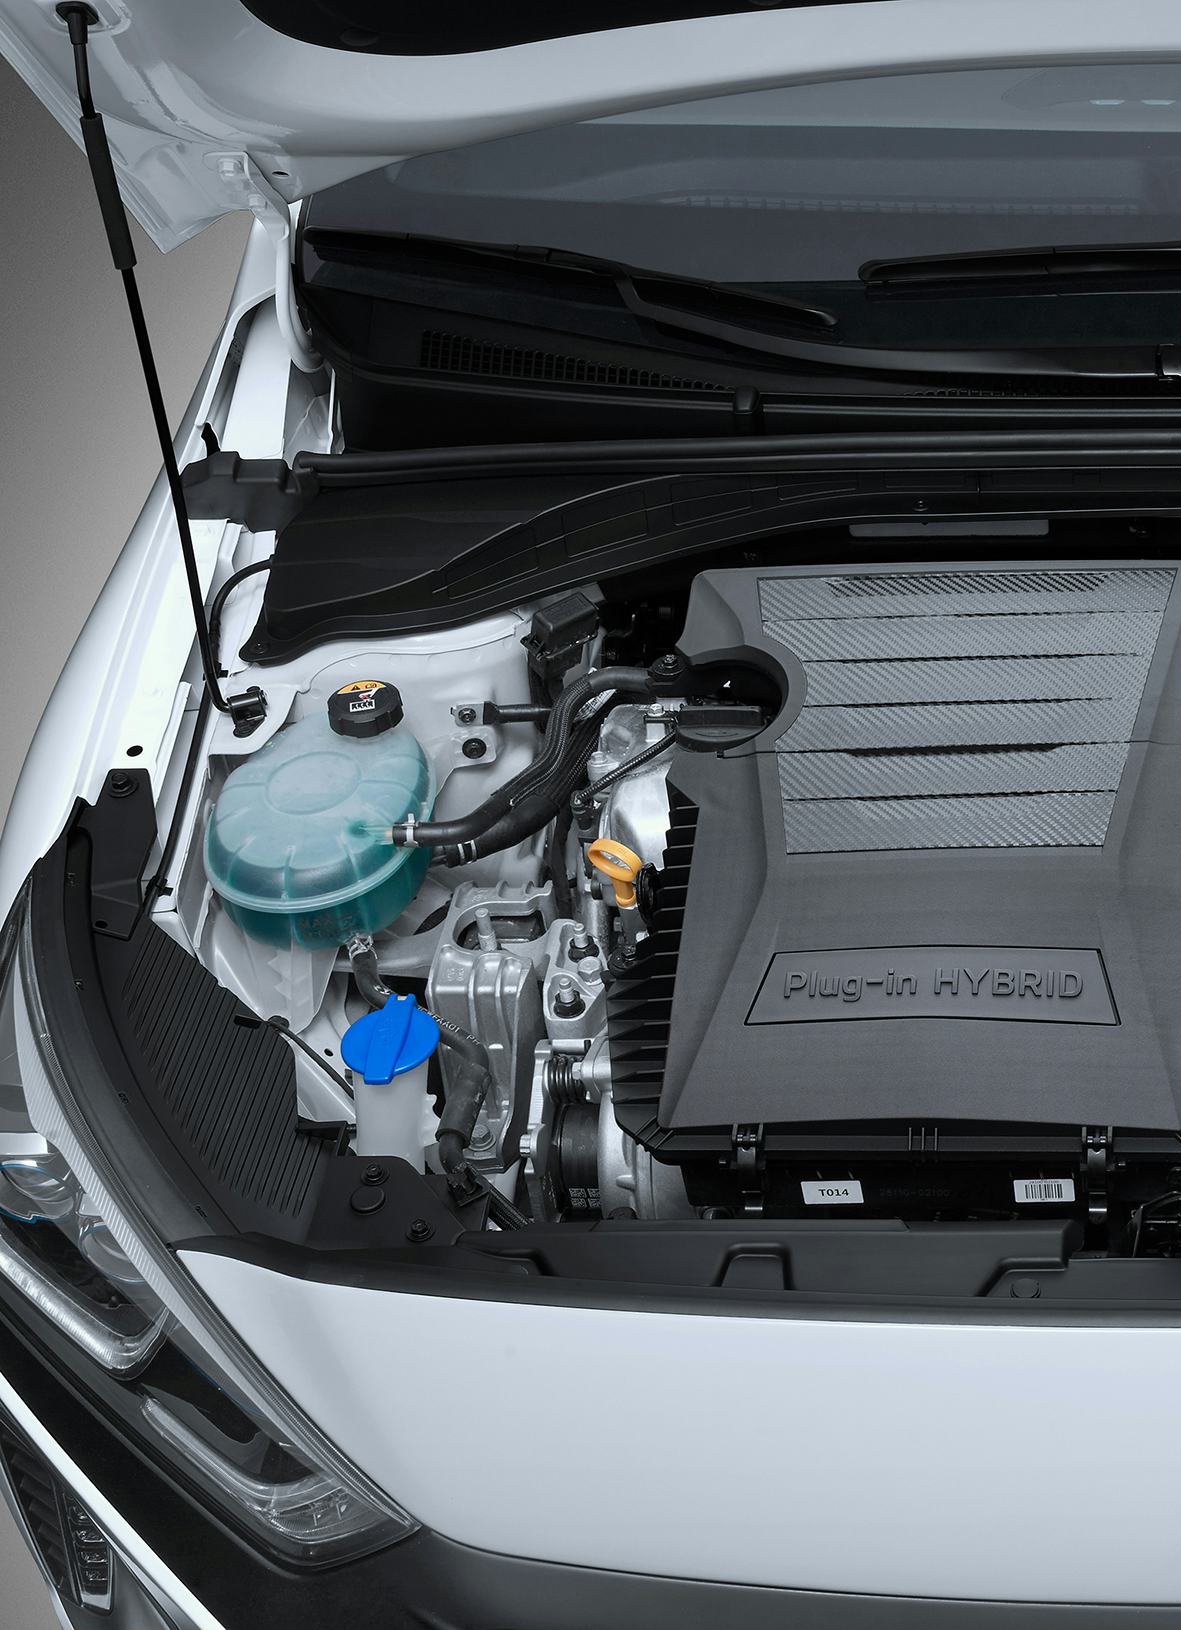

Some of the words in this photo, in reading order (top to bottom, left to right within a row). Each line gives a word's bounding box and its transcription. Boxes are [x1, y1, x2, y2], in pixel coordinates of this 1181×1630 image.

[783, 968, 918, 1002] Plug-in
[933, 967, 1084, 998] HYBRID
[818, 1188, 849, 1197] T014
